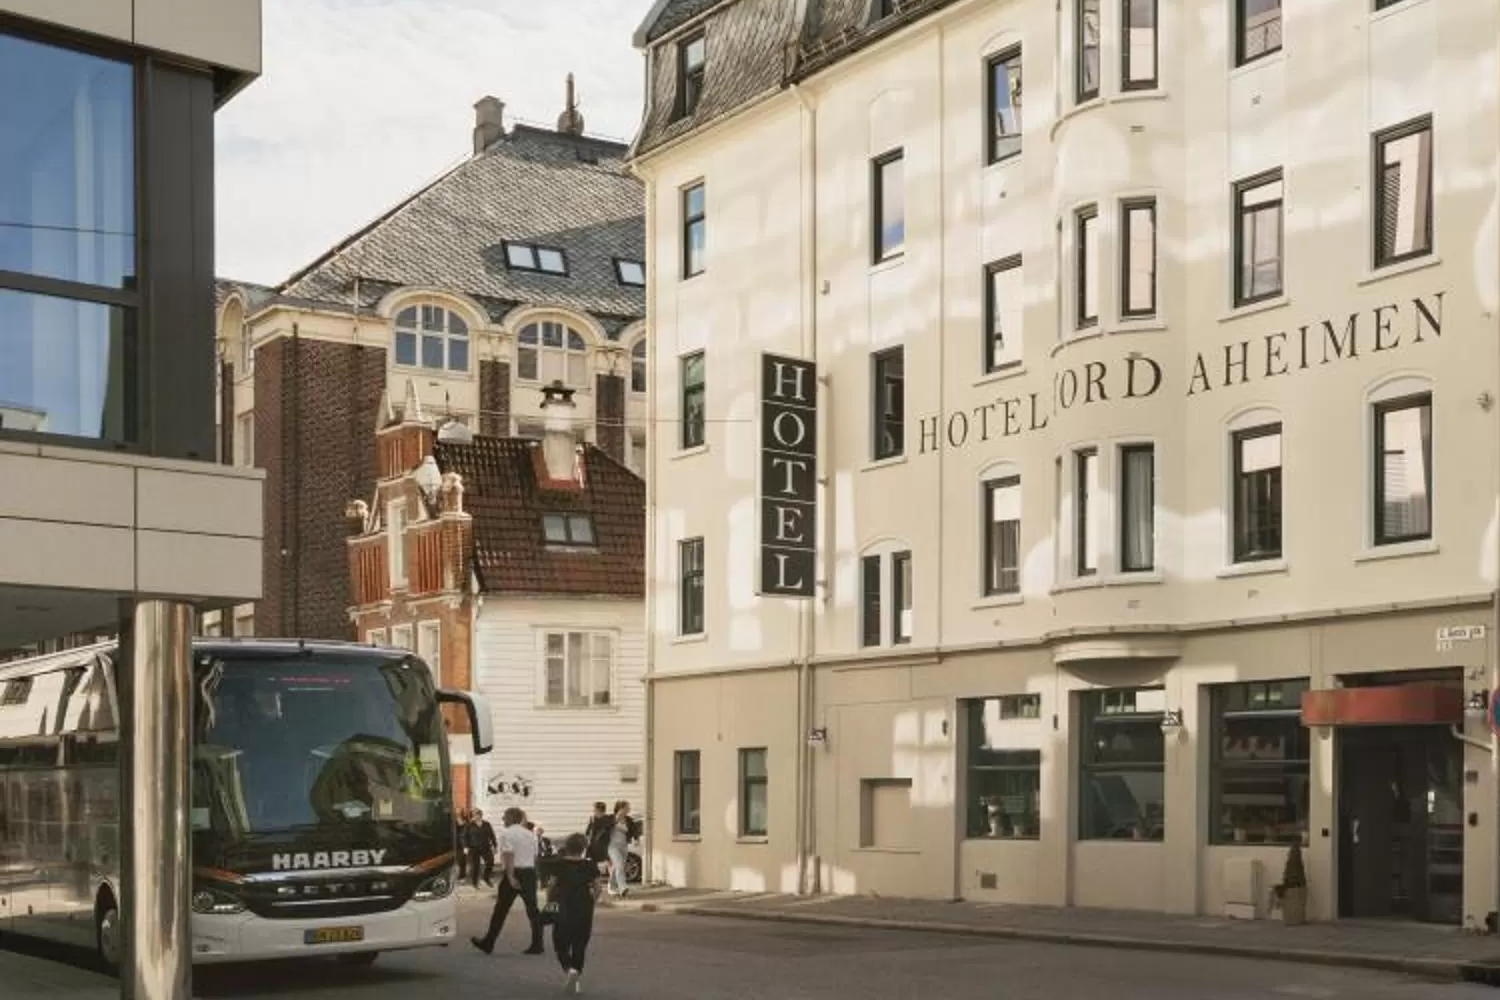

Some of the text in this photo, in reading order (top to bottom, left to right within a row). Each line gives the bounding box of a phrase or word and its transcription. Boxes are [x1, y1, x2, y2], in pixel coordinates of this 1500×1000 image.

[919, 391, 1050, 455] HOTEL
[773, 361, 807, 590] HOTEL
[272, 848, 388, 871] HAARBY
